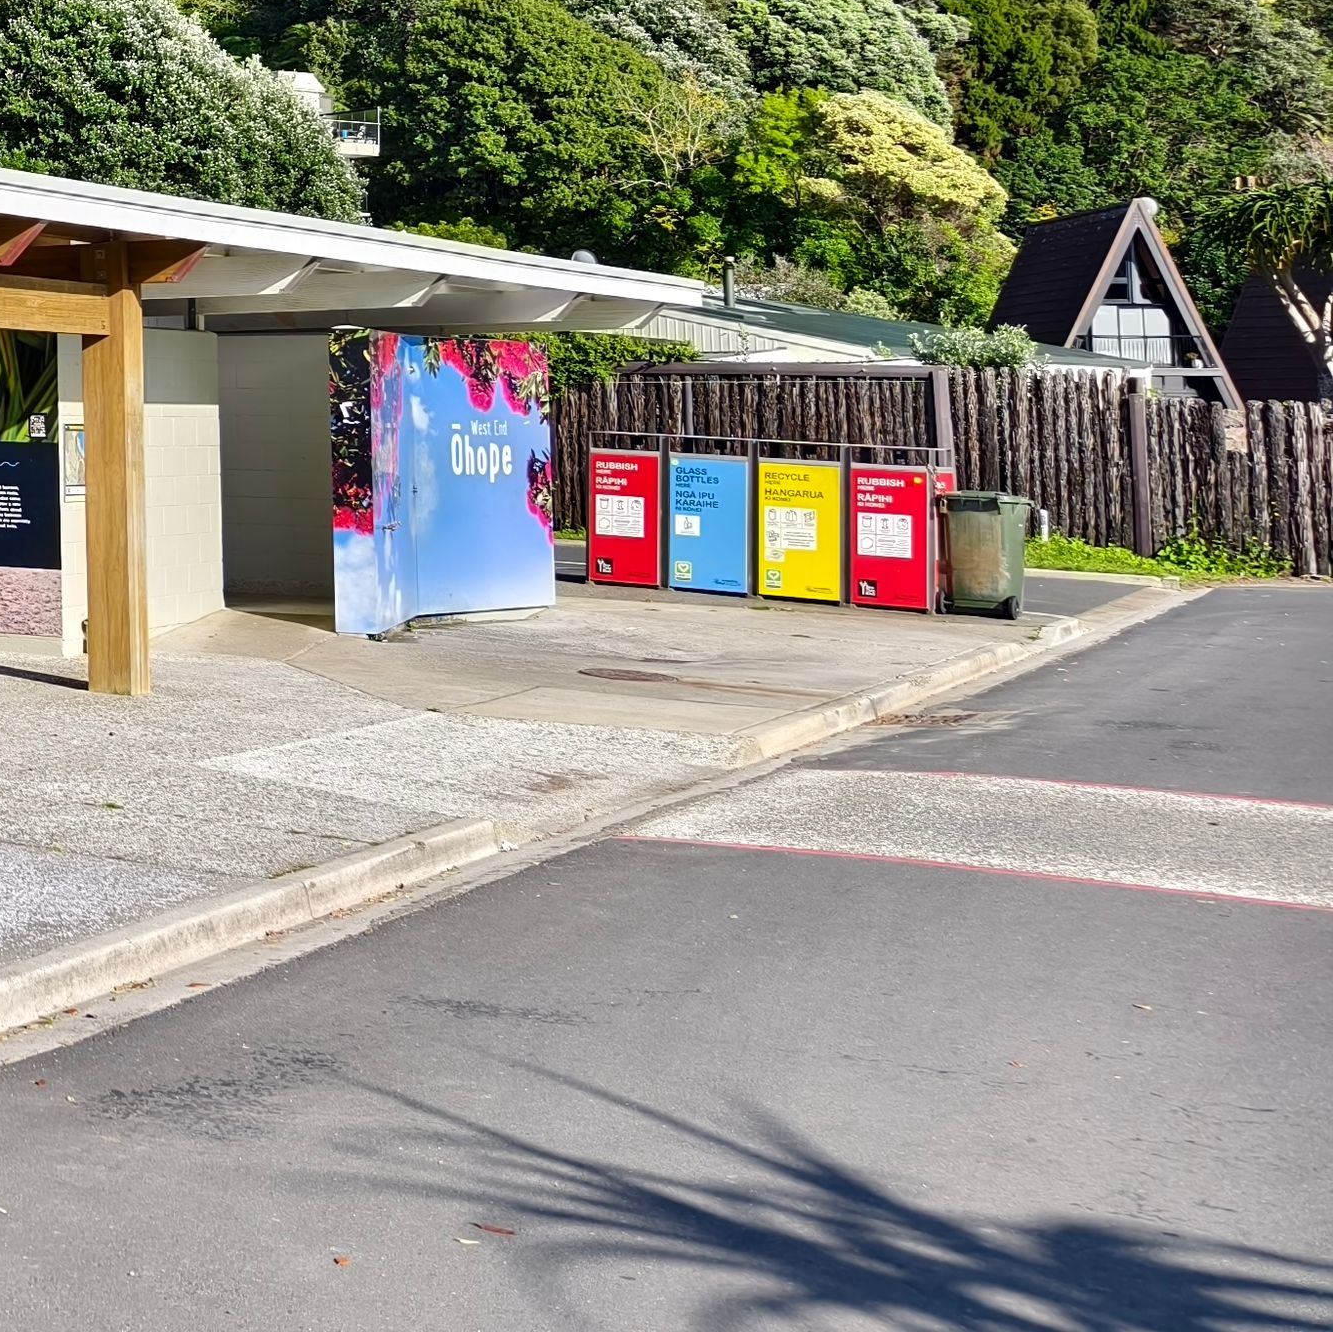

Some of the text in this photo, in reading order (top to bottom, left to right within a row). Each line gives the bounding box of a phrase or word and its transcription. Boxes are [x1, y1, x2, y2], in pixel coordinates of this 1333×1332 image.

[470, 420, 508, 436] West End
[451, 423, 512, 483] Ōhope
[595, 461, 638, 471] RUBBISH
[675, 466, 708, 475] GLASS
[675, 474, 720, 484] BOTTLES
[764, 472, 810, 481] RECYCLE
[857, 477, 905, 487] RUBBISH
[698, 491, 715, 500] IPU
[764, 488, 824, 499] HANGARUA
[675, 498, 719, 509] KARAIHE
